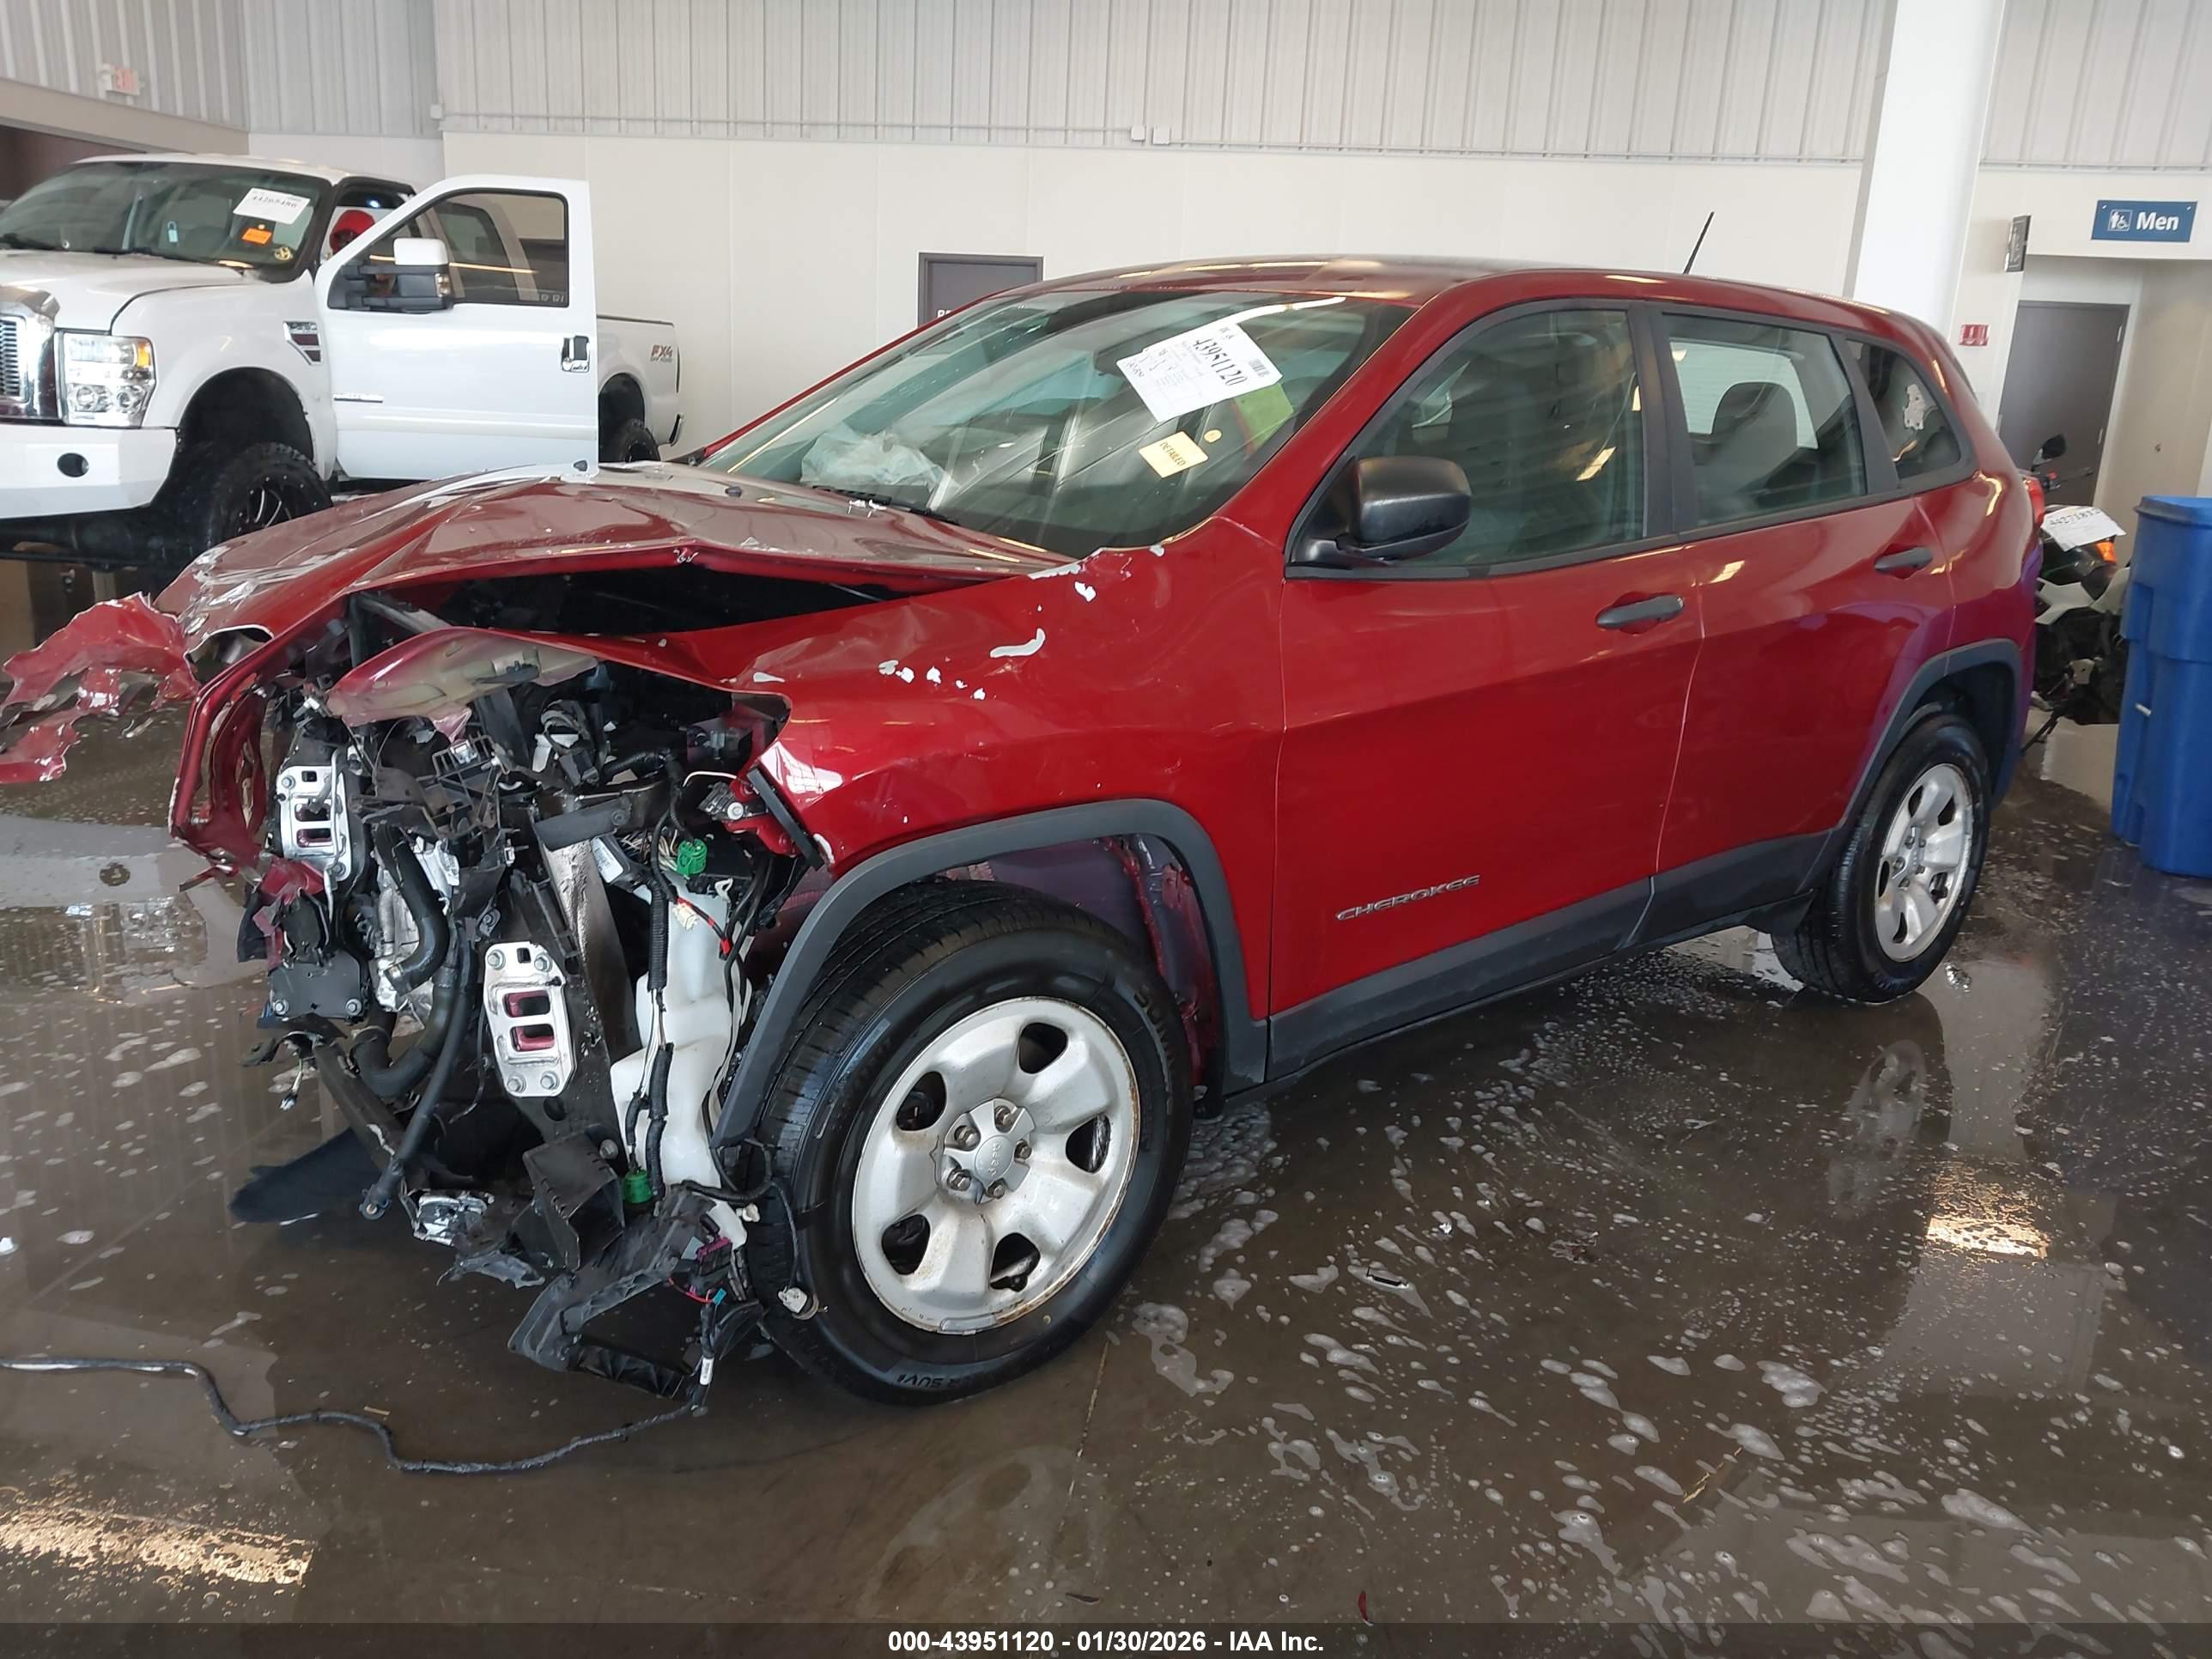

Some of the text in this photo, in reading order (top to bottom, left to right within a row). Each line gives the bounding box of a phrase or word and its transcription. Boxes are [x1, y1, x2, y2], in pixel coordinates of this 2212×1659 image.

[2136, 211, 2179, 230] Men
[652, 344, 672, 357] FX4
[1193, 337, 1248, 386] 43951120
[1336, 875, 1480, 921] CHEROKEE
